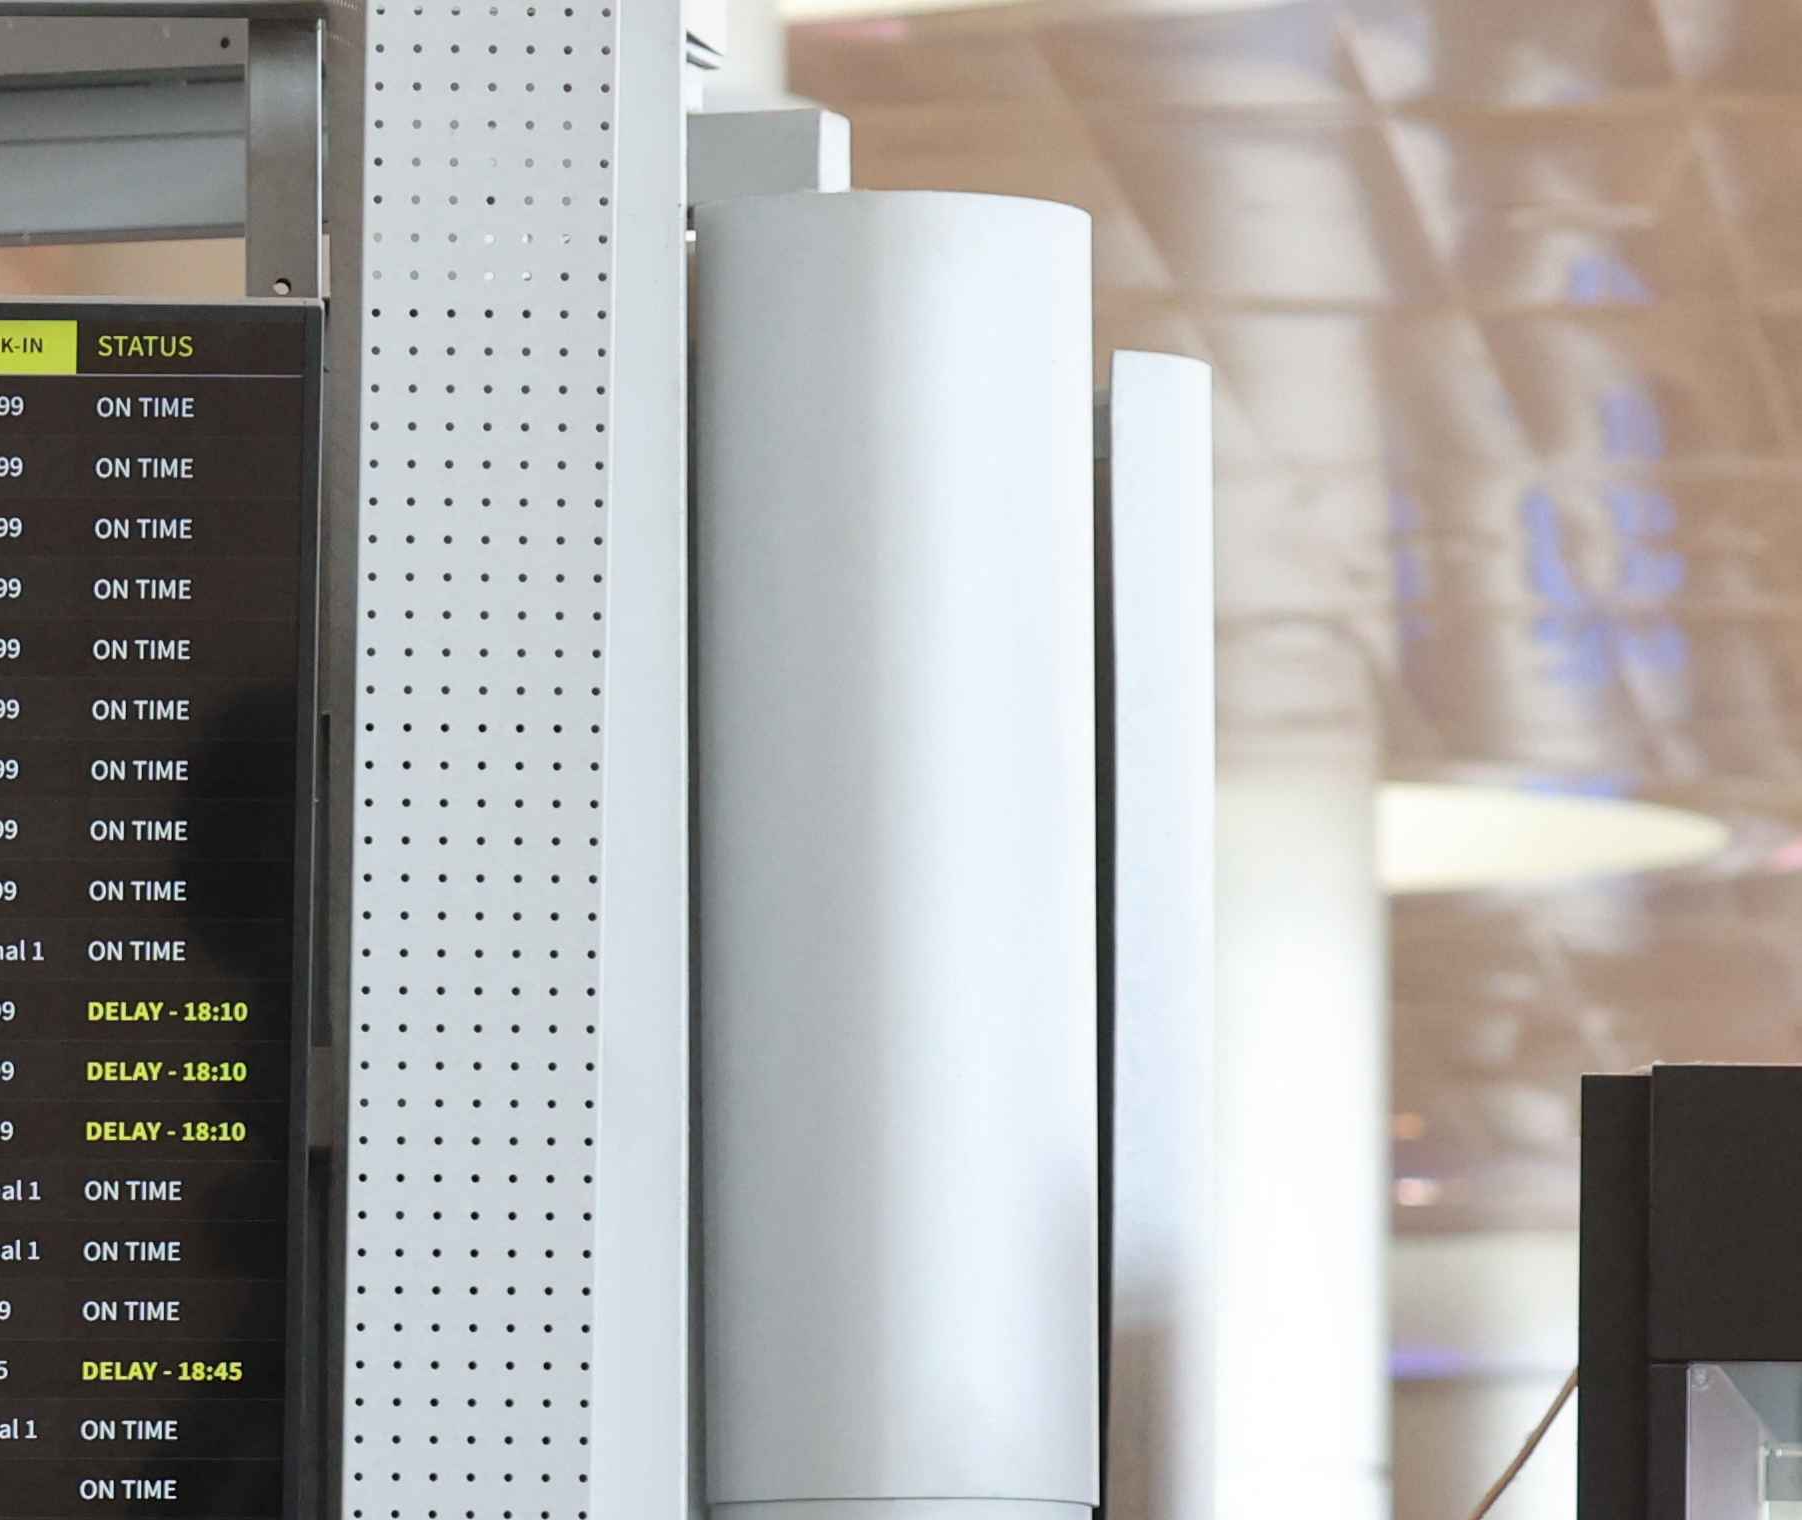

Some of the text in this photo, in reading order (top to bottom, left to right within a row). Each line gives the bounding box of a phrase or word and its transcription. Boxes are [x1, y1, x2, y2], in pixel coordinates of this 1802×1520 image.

[97, 335, 194, 358] STATUS
[95, 457, 131, 479] ON
[136, 457, 194, 479] TIME
[94, 517, 130, 540] ON
[136, 518, 193, 540] TIME
[90, 759, 126, 781] ON
[132, 759, 189, 781] TIME
[86, 1121, 162, 1141] DELAY
[181, 1121, 246, 1142] 18:10
[27, 1240, 41, 1261] 1
[83, 1240, 119, 1262] ON
[124, 1241, 181, 1262] TIME
[79, 1479, 115, 1500] ON
[120, 1479, 177, 1500] TIME
